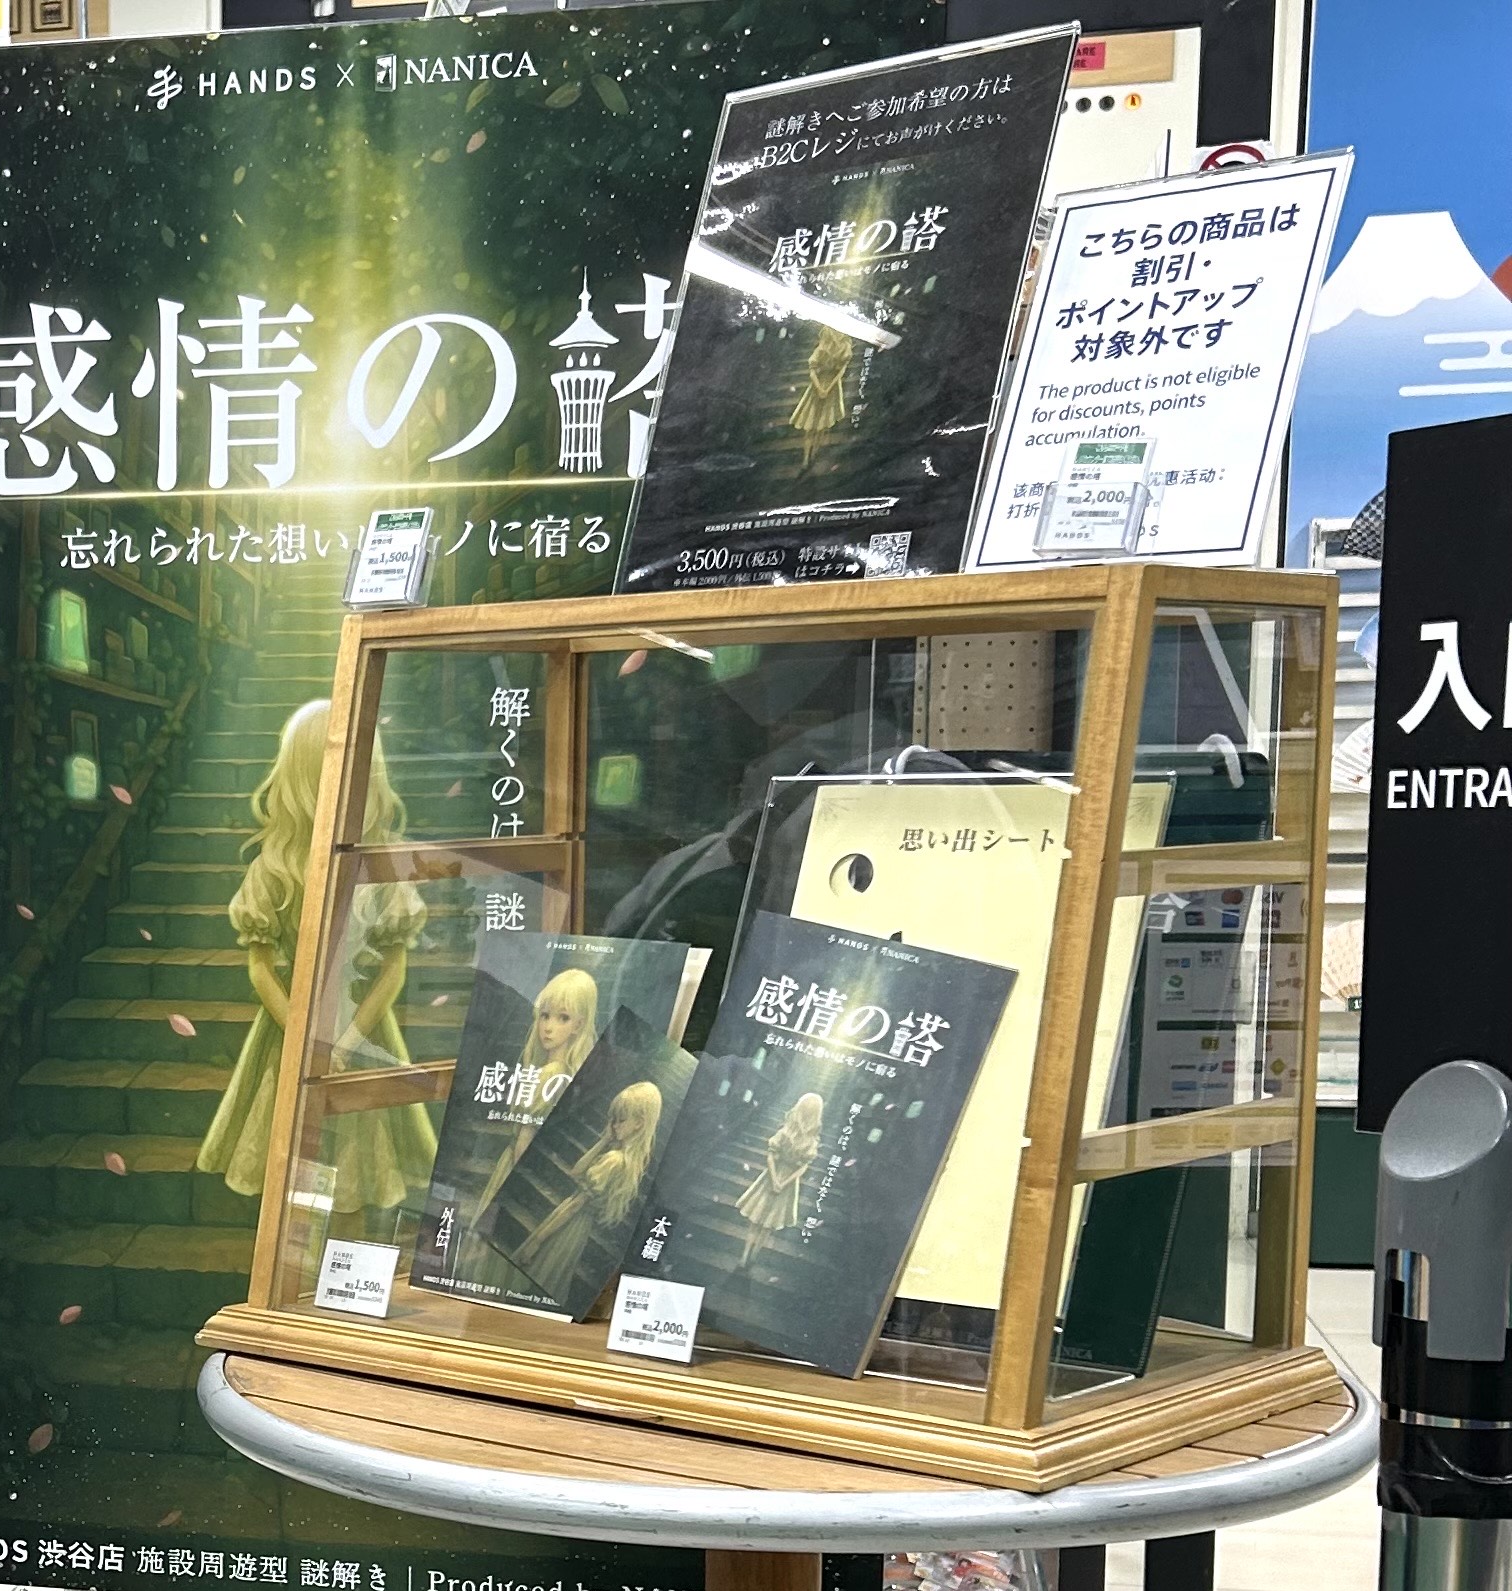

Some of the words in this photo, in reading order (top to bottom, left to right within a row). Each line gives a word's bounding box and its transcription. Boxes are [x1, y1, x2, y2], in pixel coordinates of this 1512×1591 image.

[198, 66, 317, 98] HANDS
[404, 50, 540, 86] NANICA
[765, 74, 1014, 140] 謎解きへご参加希望の方は
[762, 112, 1009, 168] B2Cレジにてお声がけください。
[768, 205, 950, 273] 感情の塔
[1079, 203, 1301, 258] こちらの商品は
[1055, 277, 1264, 330] ポイントアップ
[1070, 318, 1234, 363] 対象外です
[1039, 384, 1069, 400] The
[1072, 376, 1141, 400] product
[1144, 373, 1157, 389] is
[1162, 370, 1194, 387] not
[1196, 362, 1261, 387] eligible
[1031, 406, 1056, 424] for
[1059, 400, 1145, 421] discounts,
[1149, 393, 1207, 416] points
[1025, 422, 1146, 447] accumulation.
[59, 514, 614, 571] 忘れられた想いノに宿る
[1396, 620, 1512, 735] 入
[1386, 766, 1512, 810] ENTRA
[898, 827, 1055, 853] 思い出シート
[484, 892, 526, 932] 謎
[745, 974, 951, 1068] 感情の塔
[473, 1060, 574, 1108] 感情の
[640, 1215, 672, 1262] 本編
[37, 1539, 125, 1572] 渋谷店
[137, 1546, 289, 1585] 施設周遊型
